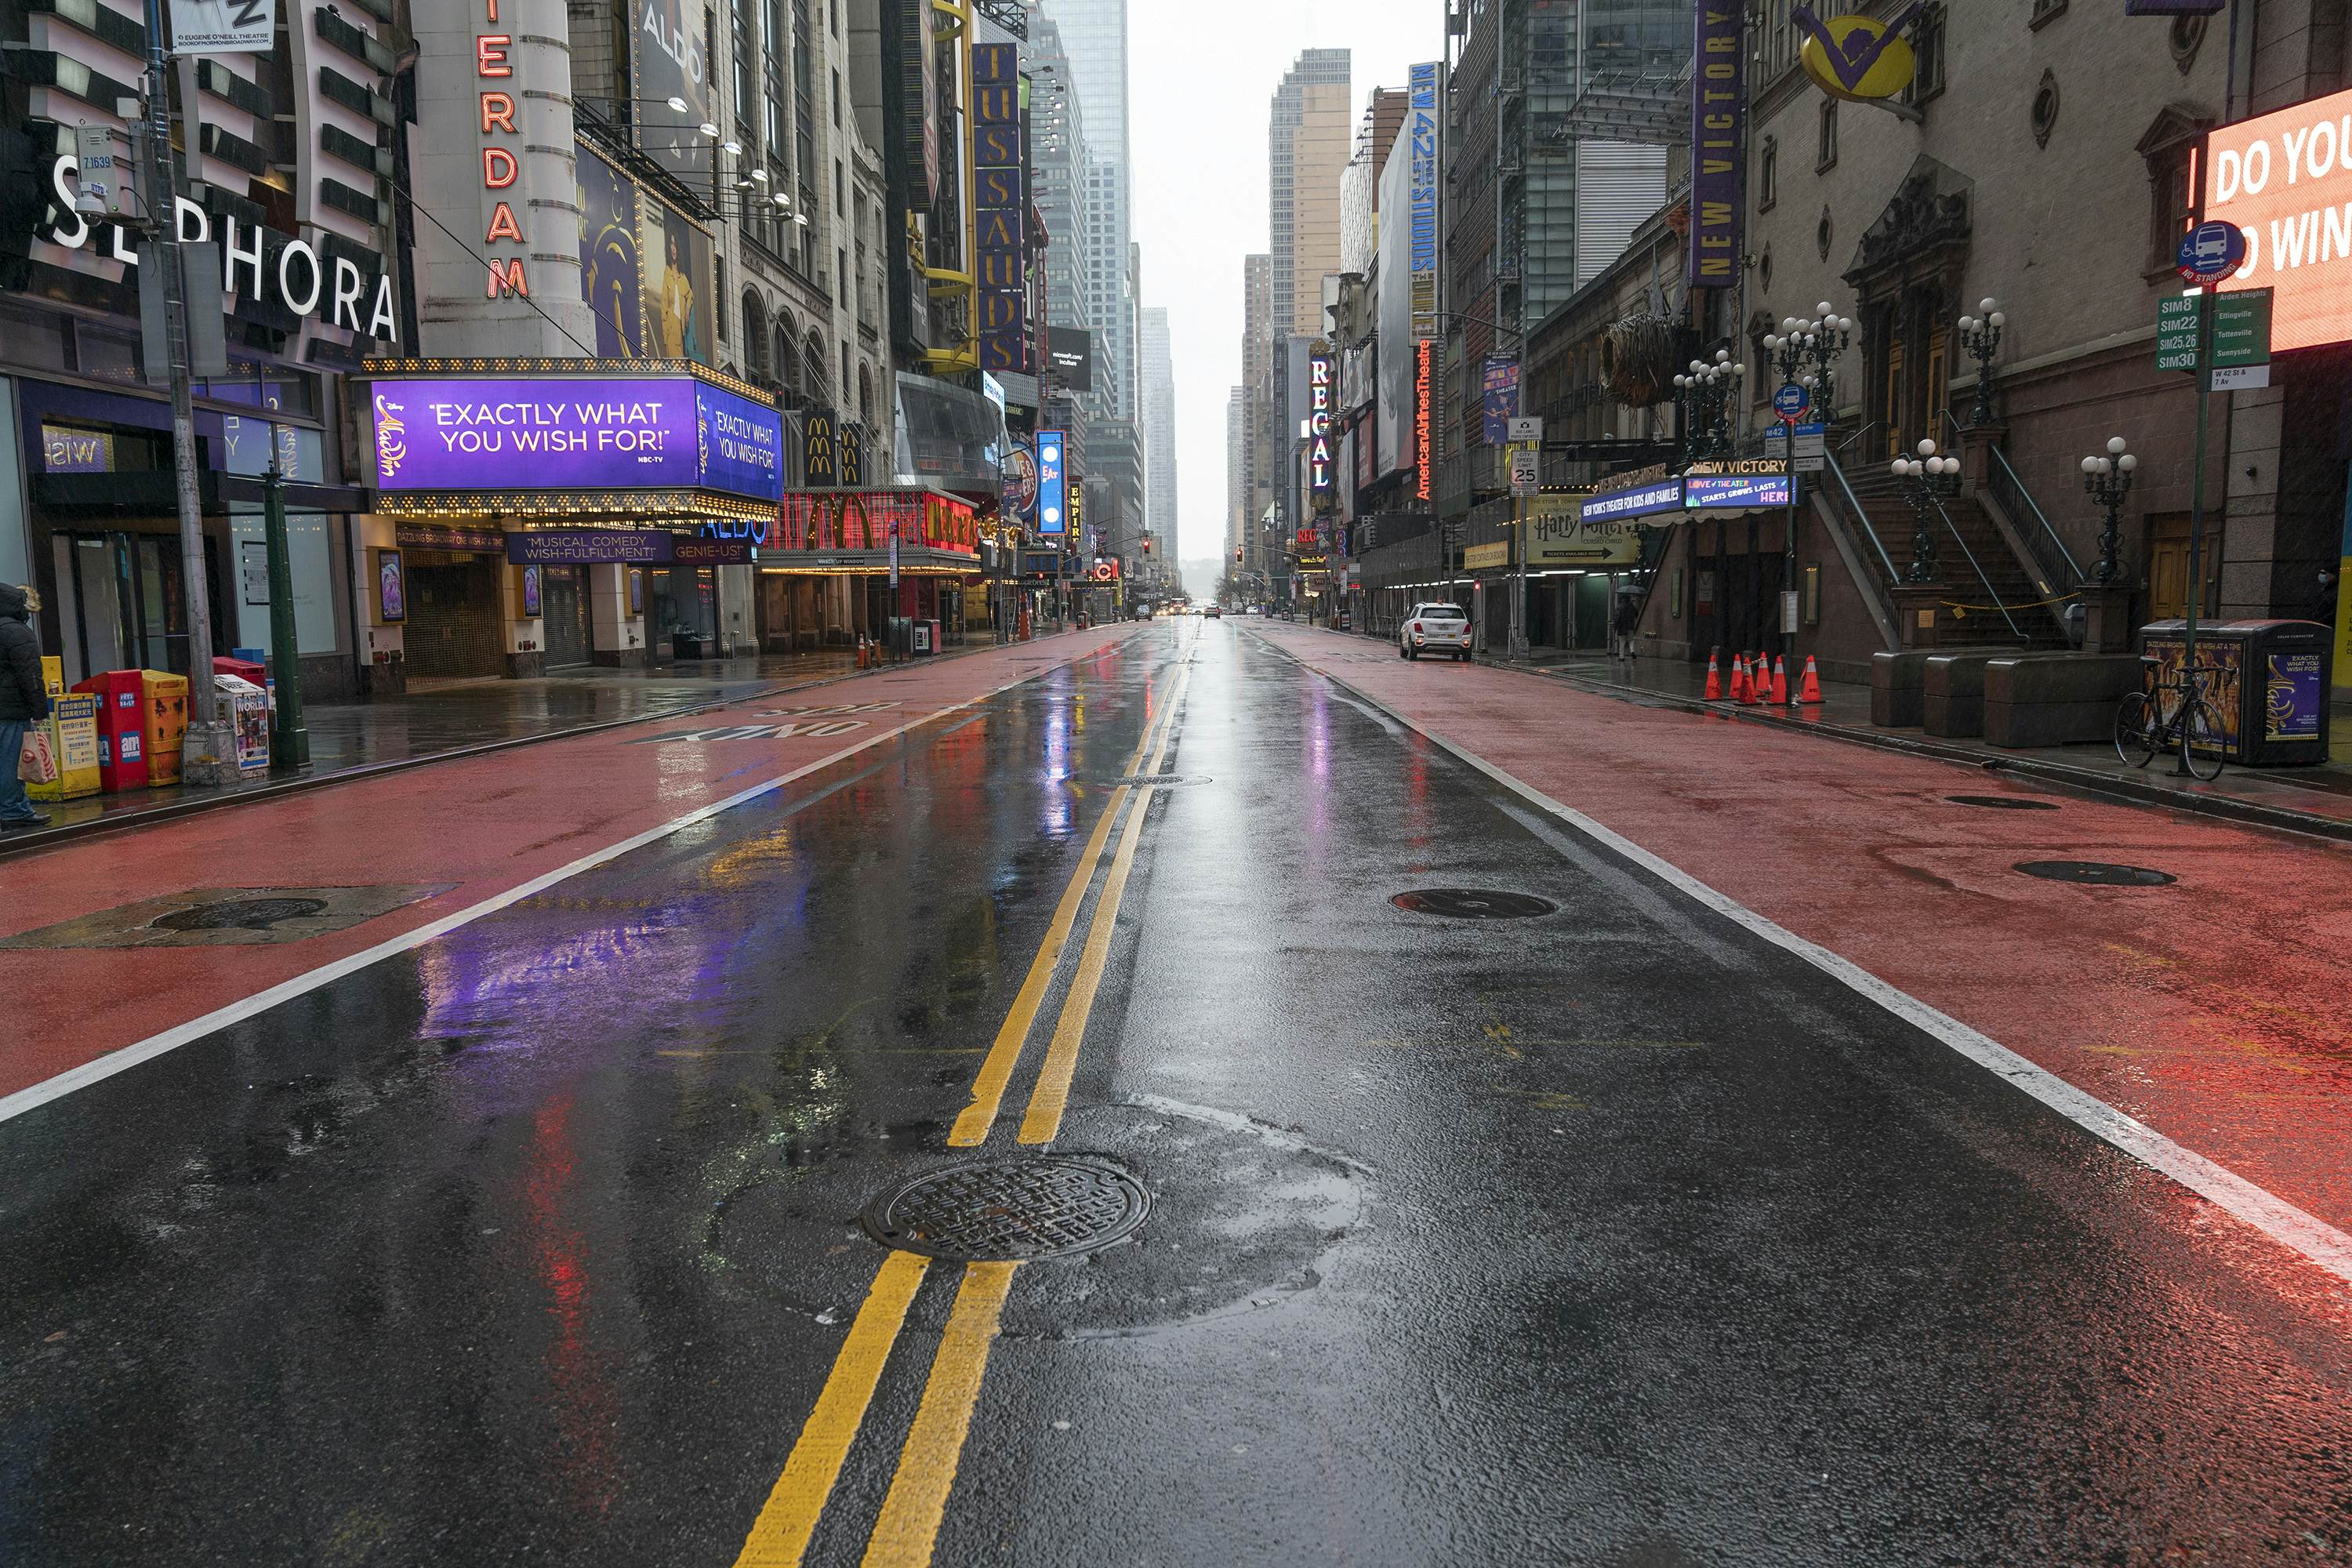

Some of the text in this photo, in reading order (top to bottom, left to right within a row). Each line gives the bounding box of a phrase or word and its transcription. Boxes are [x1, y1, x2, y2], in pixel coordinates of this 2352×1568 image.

[643, 2, 702, 84] ALDO
[1412, 64, 1435, 109] NEW
[1700, 10, 1737, 275] NEW VICTORY
[2216, 139, 2270, 203] DO
[90, 183, 104, 194] NYPD
[1412, 187, 1436, 271] STUDIOS
[2270, 201, 2352, 272] WIN
[2182, 263, 2237, 282] NO STANDING
[2241, 290, 2267, 299] Heights
[2161, 298, 2192, 314] SIM8
[2219, 310, 2252, 320] Eltingville
[2161, 315, 2198, 332] SIM22
[2160, 334, 2197, 350] SIM25,26
[2218, 329, 2252, 339] Tottenville
[1052, 351, 1083, 361] microsoft.com/
[2159, 353, 2195, 368] SIM30
[2217, 348, 2252, 357] Sunnyside
[1496, 385, 1517, 394] THEATER
[575, 403, 663, 425] WHAT
[1310, 360, 1330, 488] REGAL
[1766, 427, 1783, 437] M42
[376, 394, 406, 477] Aladdin
[439, 430, 503, 452] YOU
[511, 430, 588, 452] WISH
[753, 423, 773, 446] WHAT
[719, 437, 737, 460] YOU
[738, 442, 757, 465] WISH
[1042, 465, 1058, 480] EAT
[1693, 459, 1788, 474] NEW VICTORY
[1514, 470, 1536, 482] 25
[1688, 480, 1711, 489] LOVE
[1701, 482, 1777, 503] STARTS GROWS LASTS
[1583, 487, 1679, 517] NEW YORK'S THEATER FOR KIDS AND FAMILIES
[1298, 528, 1316, 543] REG
[1534, 514, 1578, 542] Harry
[397, 532, 426, 543] DAZZLING
[425, 534, 456, 544] BROADWAY
[456, 535, 468, 546] ONE
[492, 538, 503, 546] TIME
[592, 536, 647, 546] COMEDY
[2266, 655, 2295, 735] Aladdin
[237, 701, 265, 712] WORLD.
[121, 736, 140, 752] am
